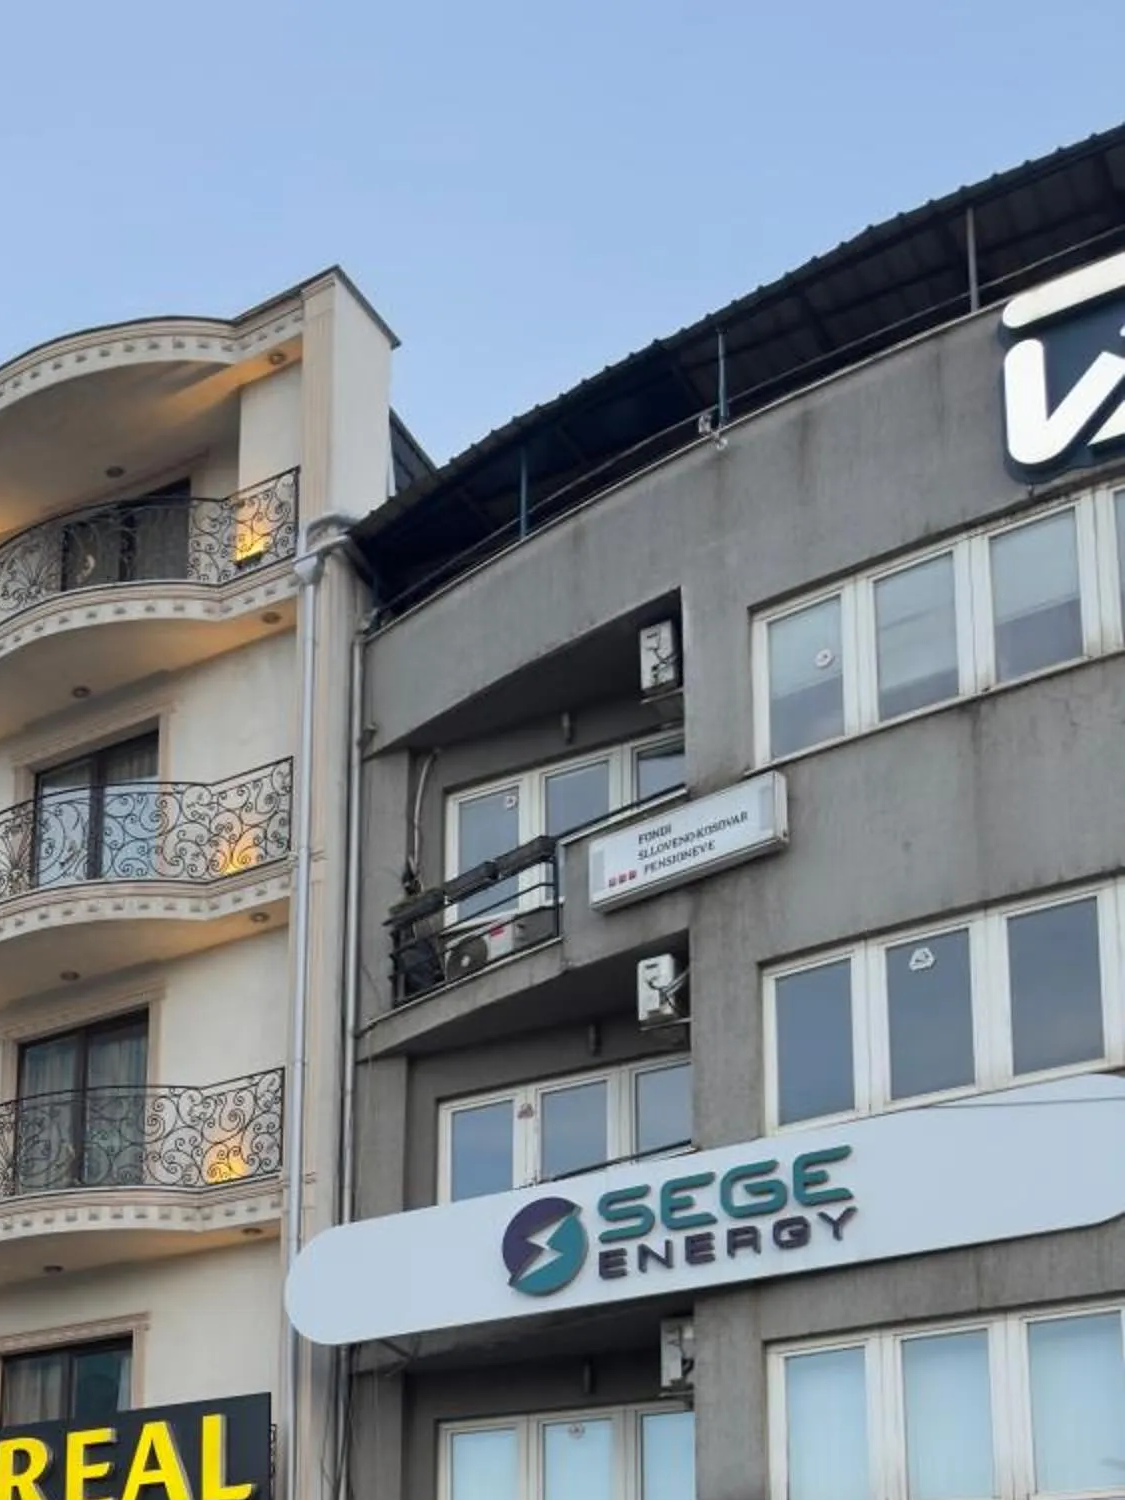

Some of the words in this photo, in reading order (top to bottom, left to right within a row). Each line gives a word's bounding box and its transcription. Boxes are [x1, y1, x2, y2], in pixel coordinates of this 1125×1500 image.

[637, 824, 672, 845] FONDI
[643, 840, 716, 875] PENSIONEVE
[597, 1144, 855, 1244] SEGE
[598, 1206, 858, 1281] ENERGY
